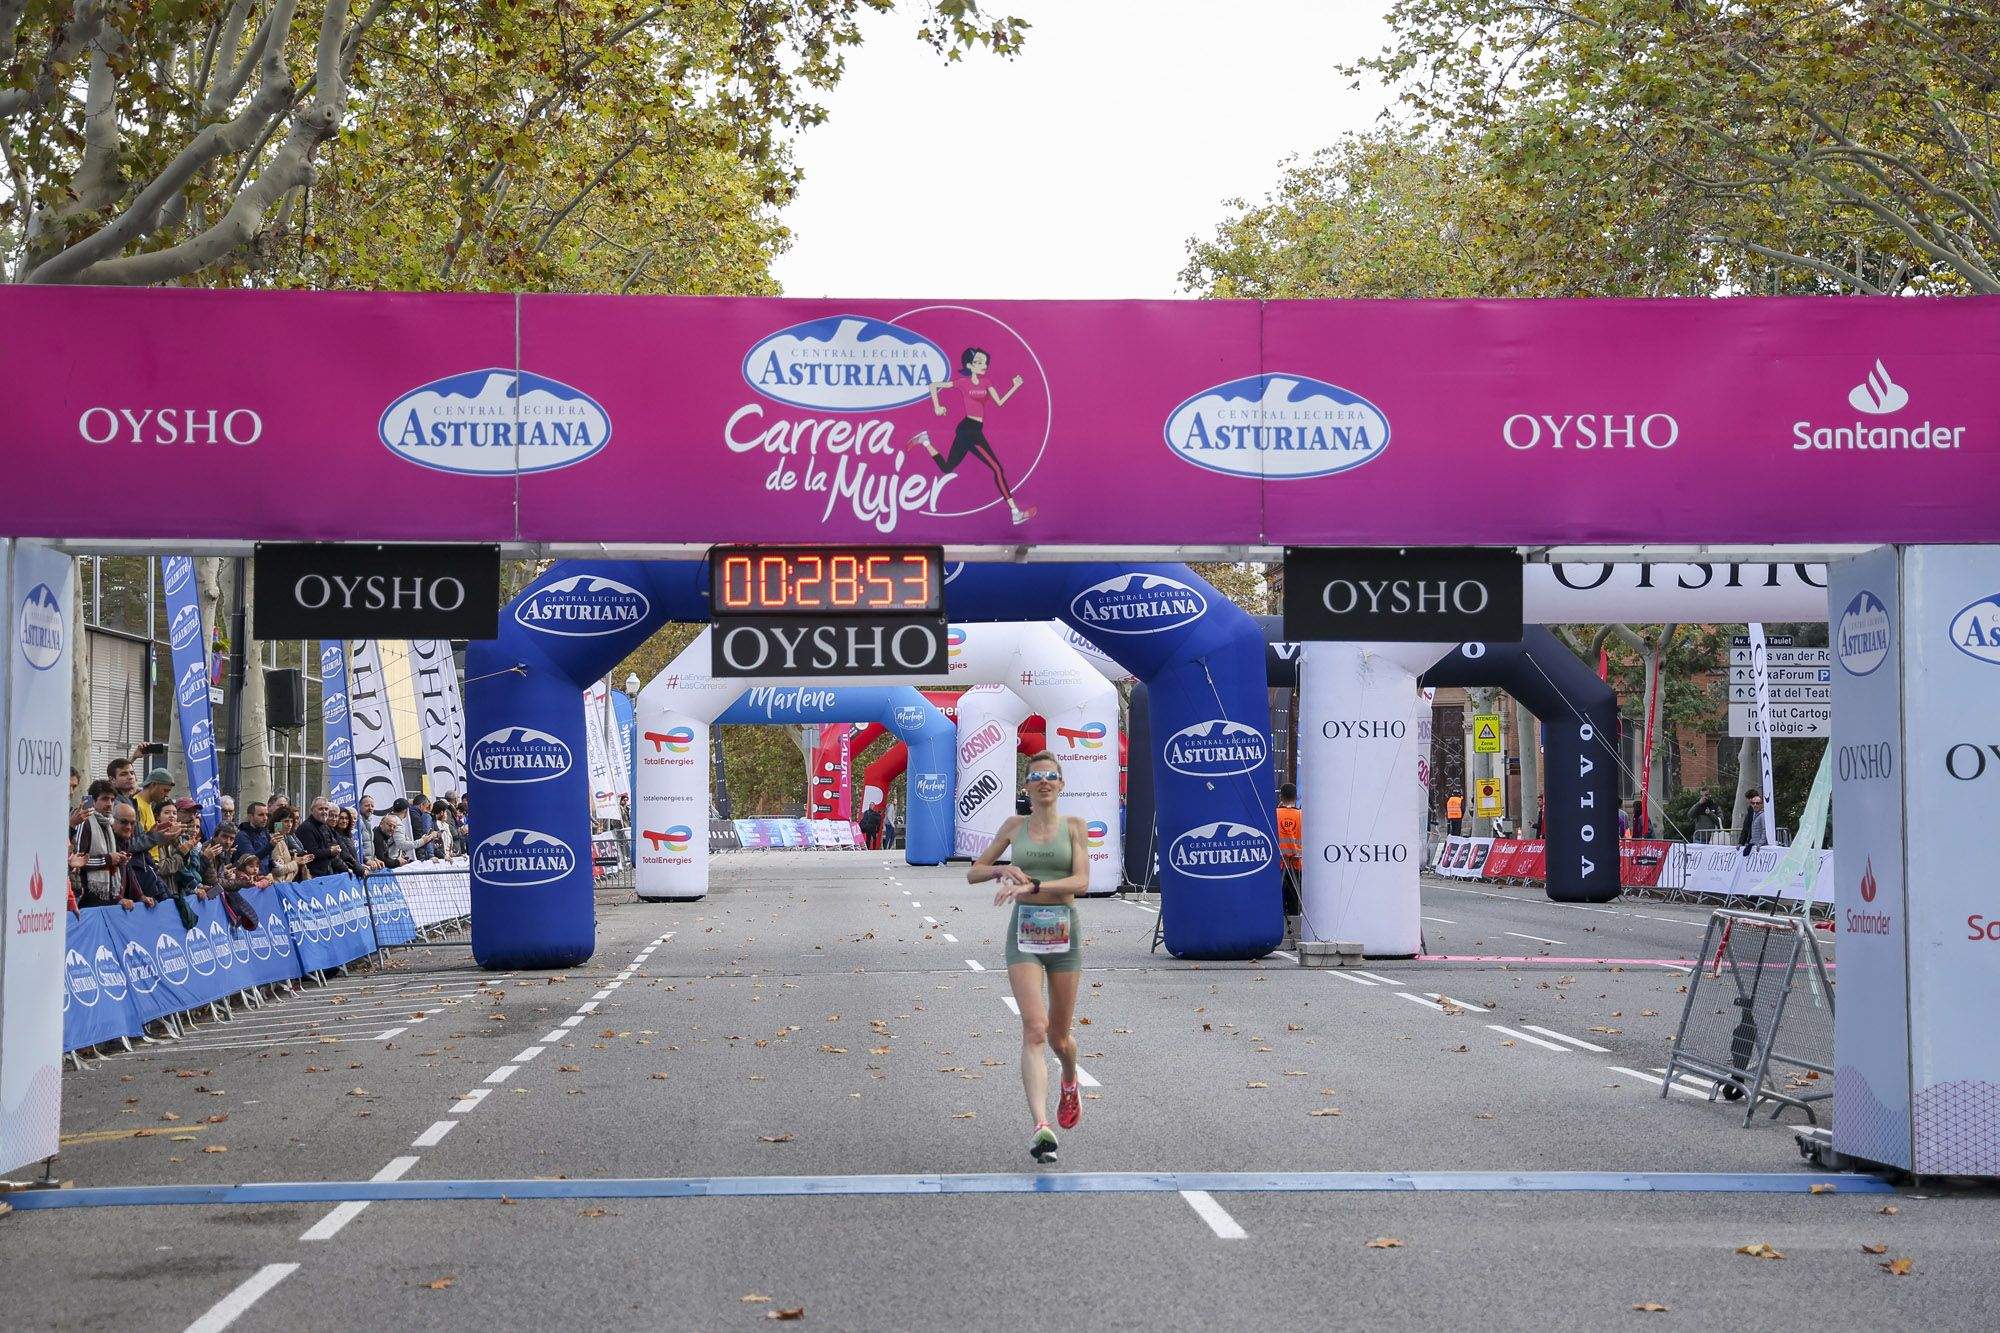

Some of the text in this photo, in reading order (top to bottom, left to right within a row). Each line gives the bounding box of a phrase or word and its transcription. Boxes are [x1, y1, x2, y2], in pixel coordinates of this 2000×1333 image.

[790, 349, 928, 358] CENTRAL LECHERA
[759, 350, 933, 387] ASTURIANA
[433, 405, 505, 416] CENTRAL
[1217, 409, 1366, 420] CENTRAL LECHERA
[79, 407, 262, 445] OYSHO
[397, 408, 593, 447] ASTURIANA
[724, 403, 896, 456] Carrera
[1183, 411, 1372, 451] ASTURIANA
[1502, 413, 1679, 451] OYSHO
[1793, 421, 1966, 451] Santander
[765, 450, 958, 533] de la Mujer
[724, 554, 931, 607] 00:28:53
[295, 573, 466, 612] OYSHO
[545, 595, 637, 603] CENTRAL LECHERA
[1098, 590, 1192, 604] CENTRAL LECHERA
[1322, 579, 1489, 615] OYSHO
[523, 599, 639, 621] ASTURIANA
[1082, 598, 1200, 622] ASTURIANA
[21, 611, 61, 652] ASTURIANA
[1840, 626, 1888, 659] ASTURIANA
[723, 623, 938, 672] OYSHO
[1776, 652, 1794, 661] van
[1797, 651, 1815, 661] der
[1748, 669, 1814, 680] CxaForum
[748, 686, 836, 719] Marlene
[1784, 687, 1801, 698] del
[1805, 687, 1831, 698] Teat
[1748, 708, 1831, 720] Initut Cartog
[1322, 720, 1406, 739] OYSHO
[960, 724, 1002, 764] COSMO
[1171, 742, 1263, 764] ASTURIANA
[18, 737, 63, 777] OYSHO
[474, 750, 566, 771] ASTURIANA
[644, 757, 694, 767] TotalEnergies
[1056, 753, 1108, 763] TotalEnergies
[1839, 741, 1892, 781] OYSHO
[643, 795, 694, 803] totalenergies.es
[959, 774, 998, 817] COSMO
[1058, 790, 1108, 798] otalenergies.es
[1580, 723, 1595, 879] VOLVO
[477, 852, 569, 874] ASTURIANA
[642, 856, 693, 866] TotalEnergies
[1175, 845, 1268, 867] ASTURIANA
[1323, 843, 1408, 863] OYSHO
[1708, 850, 1737, 872] OYSHO
[1745, 851, 1778, 873] OYSHO
[17, 908, 55, 934] Santander
[1846, 908, 1891, 936] Santander
